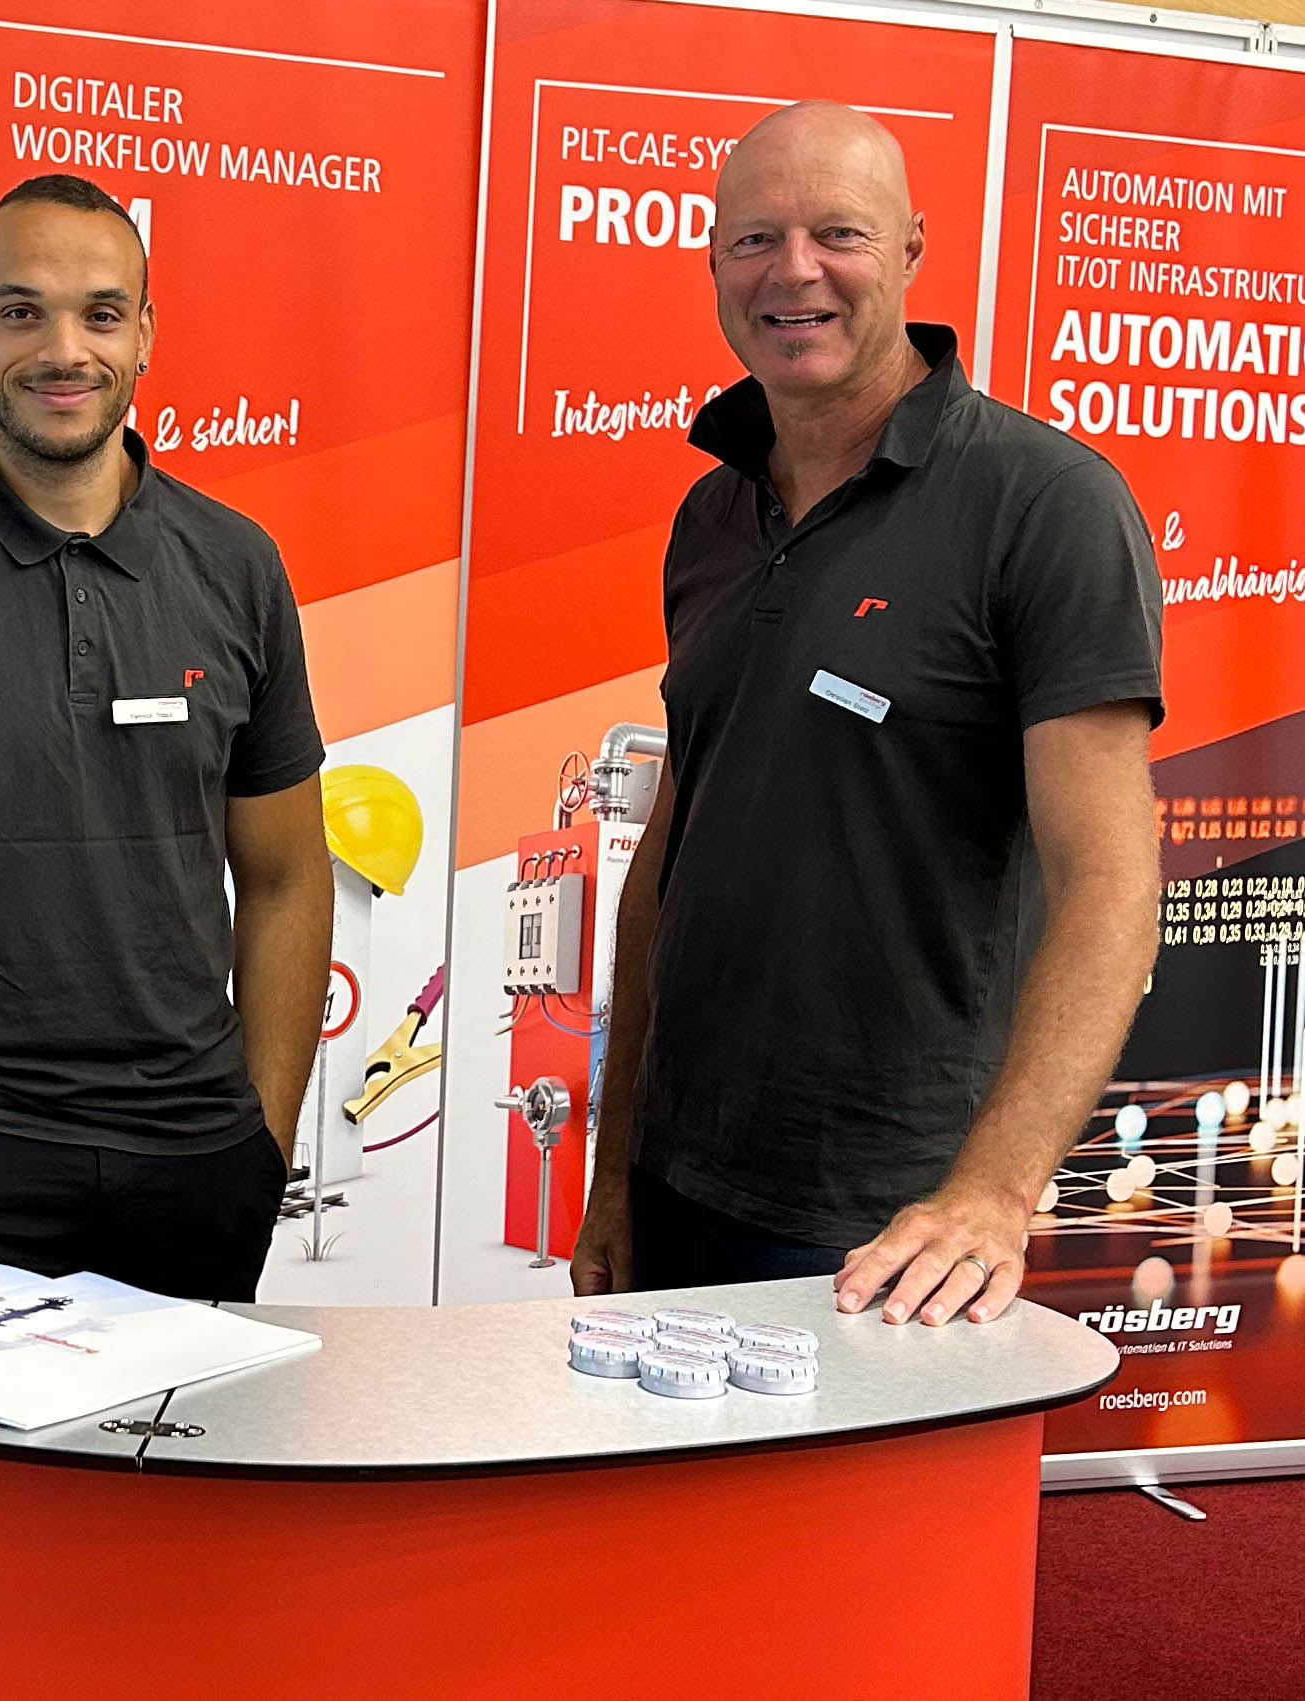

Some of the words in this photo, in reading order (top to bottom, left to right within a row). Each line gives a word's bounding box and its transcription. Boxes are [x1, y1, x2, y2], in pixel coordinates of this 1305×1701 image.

[13, 72, 183, 124] DIGITALER
[12, 123, 210, 176] WORKFLOW
[220, 144, 381, 193] MANAGER
[559, 184, 716, 249] PROD
[1062, 167, 1233, 213] AUTOMATION
[1243, 185, 1287, 218] MIT
[1059, 211, 1181, 252] SICHERER
[1057, 255, 1121, 289] IT/OT
[1050, 309, 1305, 376] AUTOMATI
[154, 407, 183, 452] &
[191, 396, 299, 452] sicher!
[551, 385, 693, 441] Integriert
[1048, 379, 1305, 445] SOLUTIONS
[1162, 511, 1185, 550] &
[1078, 1299, 1242, 1334] rösberg
[1189, 1339, 1233, 1352] Solutions
[1099, 1388, 1207, 1411] roesberg.com
